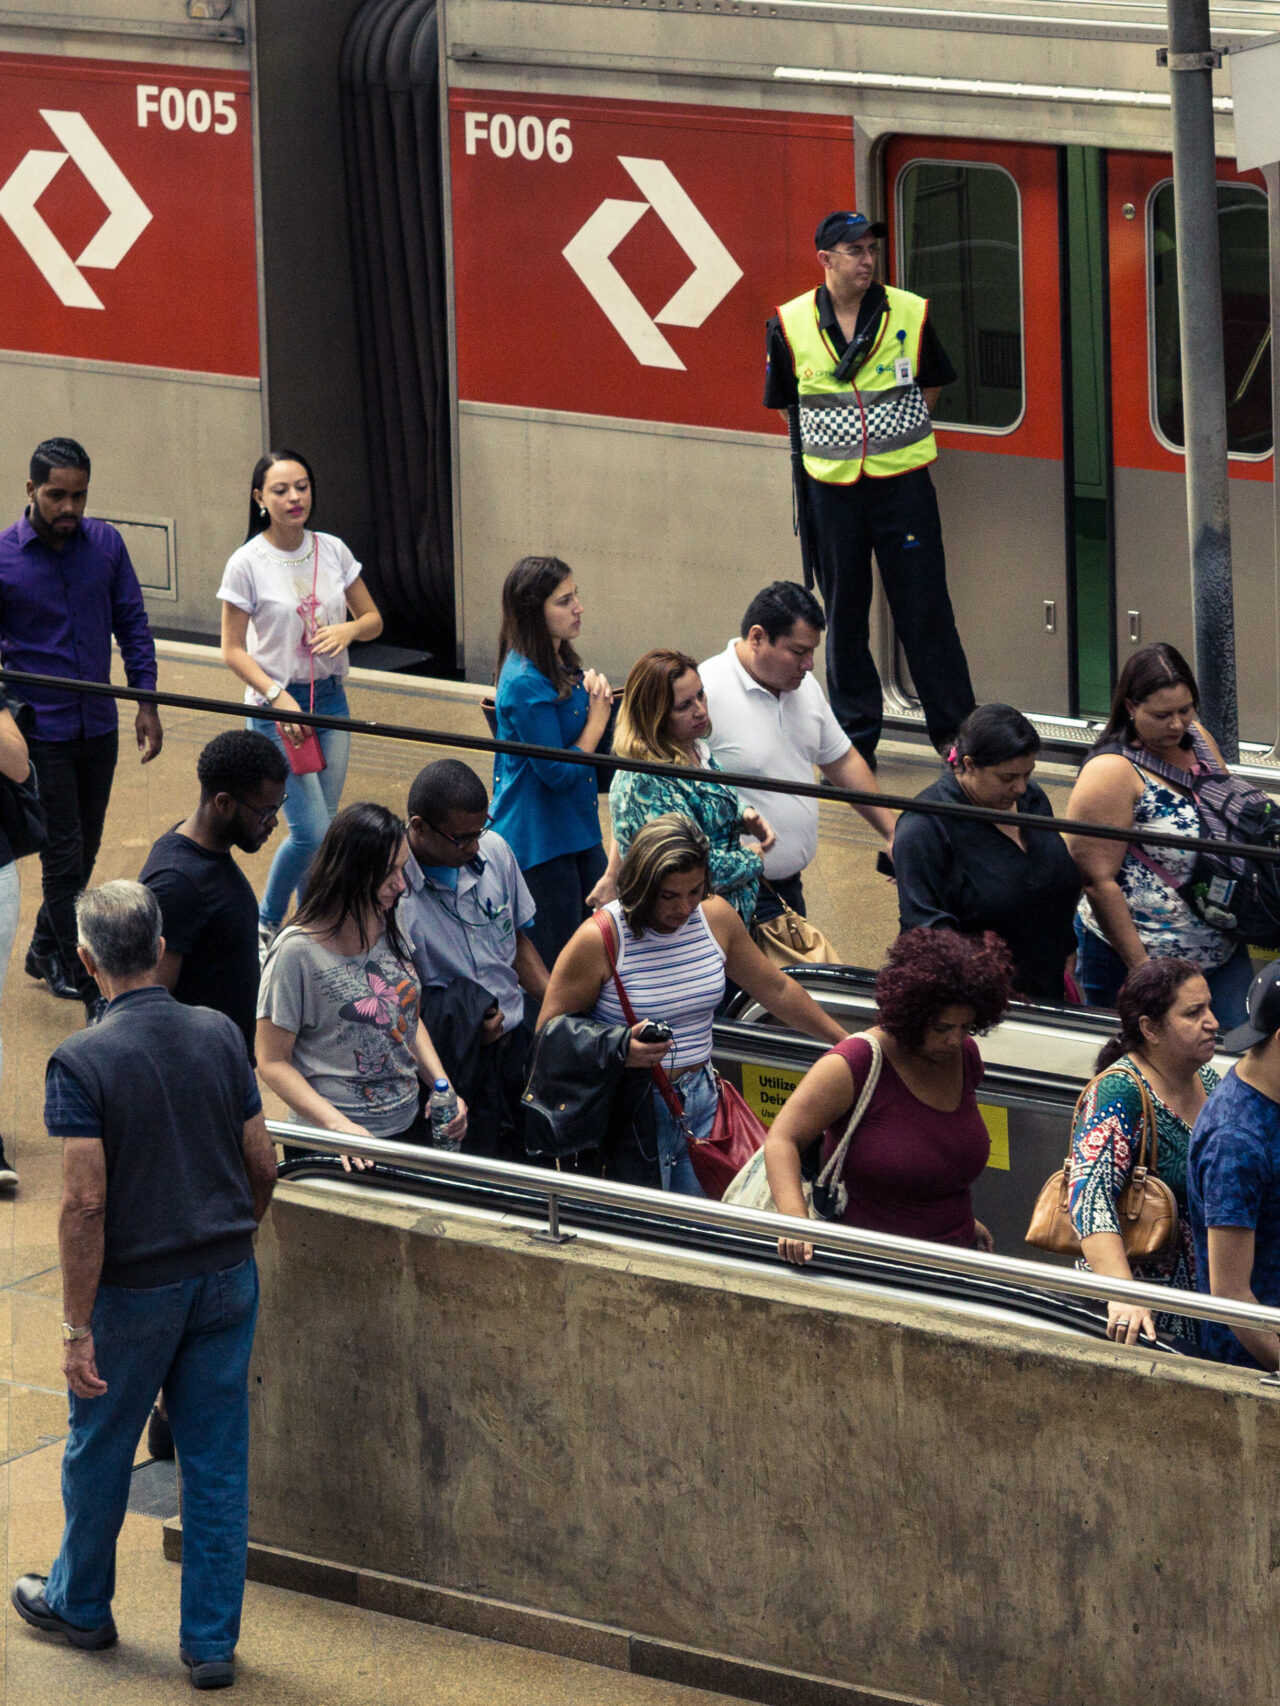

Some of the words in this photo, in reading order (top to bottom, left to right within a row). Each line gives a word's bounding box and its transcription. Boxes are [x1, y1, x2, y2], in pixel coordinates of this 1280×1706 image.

[136, 84, 237, 135] F005
[464, 112, 573, 163] F006
[759, 1075, 796, 1091] Utilize
[760, 1091, 786, 1106] Deix
[761, 1108, 776, 1118] Use
